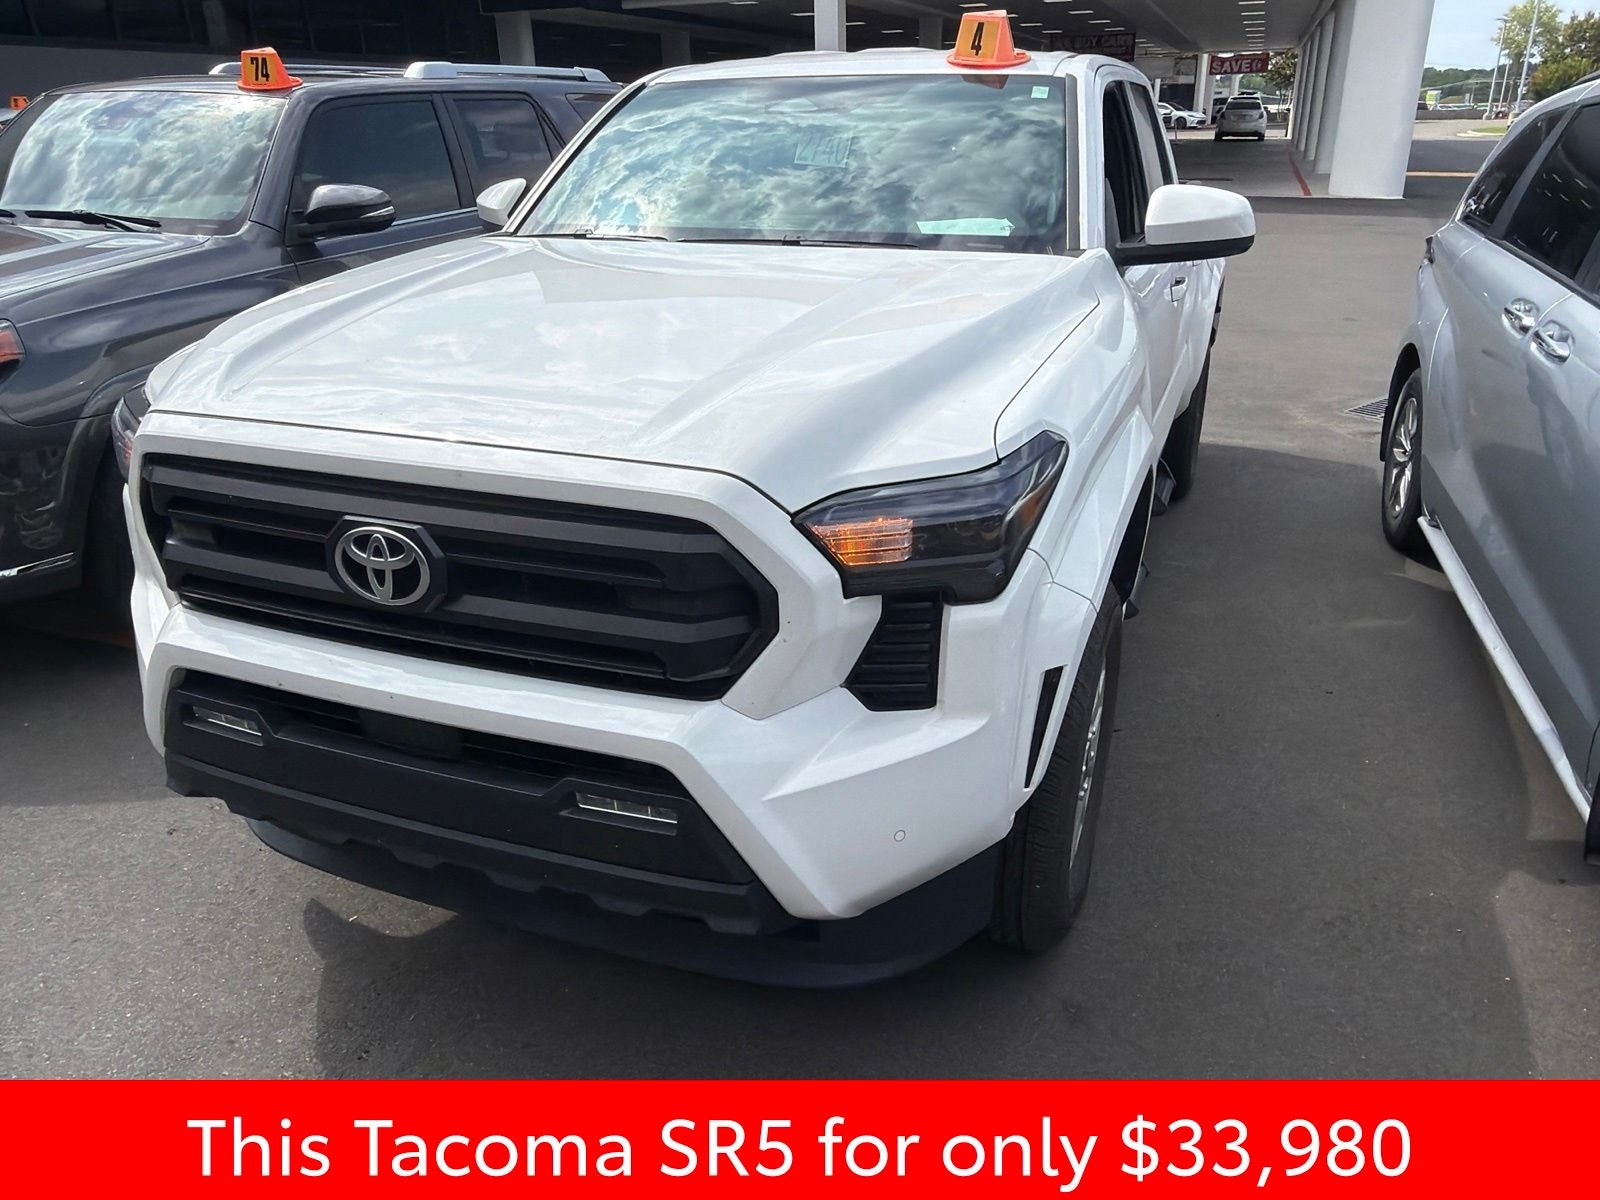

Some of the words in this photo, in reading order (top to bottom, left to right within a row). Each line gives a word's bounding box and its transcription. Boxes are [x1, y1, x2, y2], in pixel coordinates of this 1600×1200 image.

[970, 21, 985, 57] 4
[250, 56, 271, 82] 74
[1211, 59, 1251, 74] SAVE
